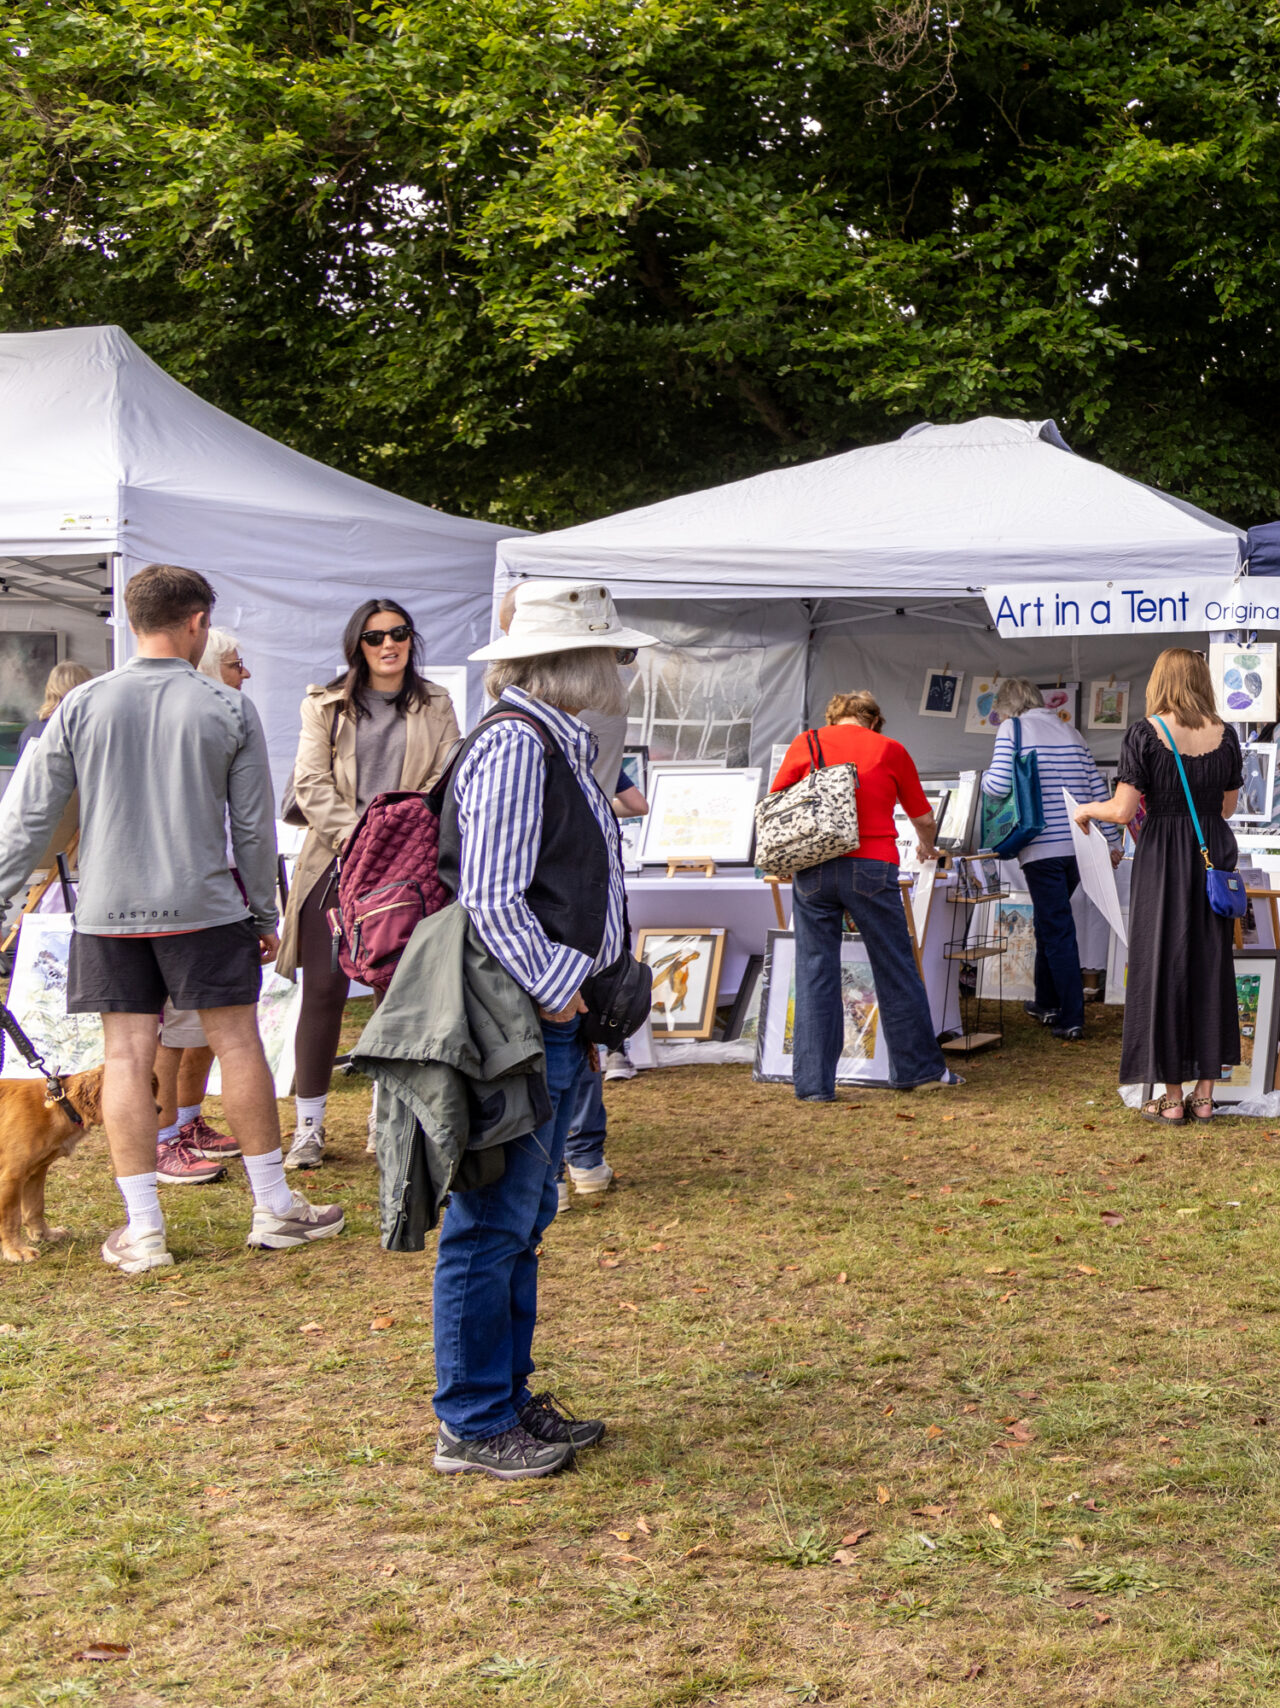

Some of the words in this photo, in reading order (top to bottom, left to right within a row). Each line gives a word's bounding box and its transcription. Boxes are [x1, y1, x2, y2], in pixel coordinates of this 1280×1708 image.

[995, 596, 1045, 629] Art
[1056, 592, 1080, 626] in
[1091, 601, 1111, 625] a
[1121, 589, 1190, 623] Tent
[108, 910, 181, 920] CASTORE
